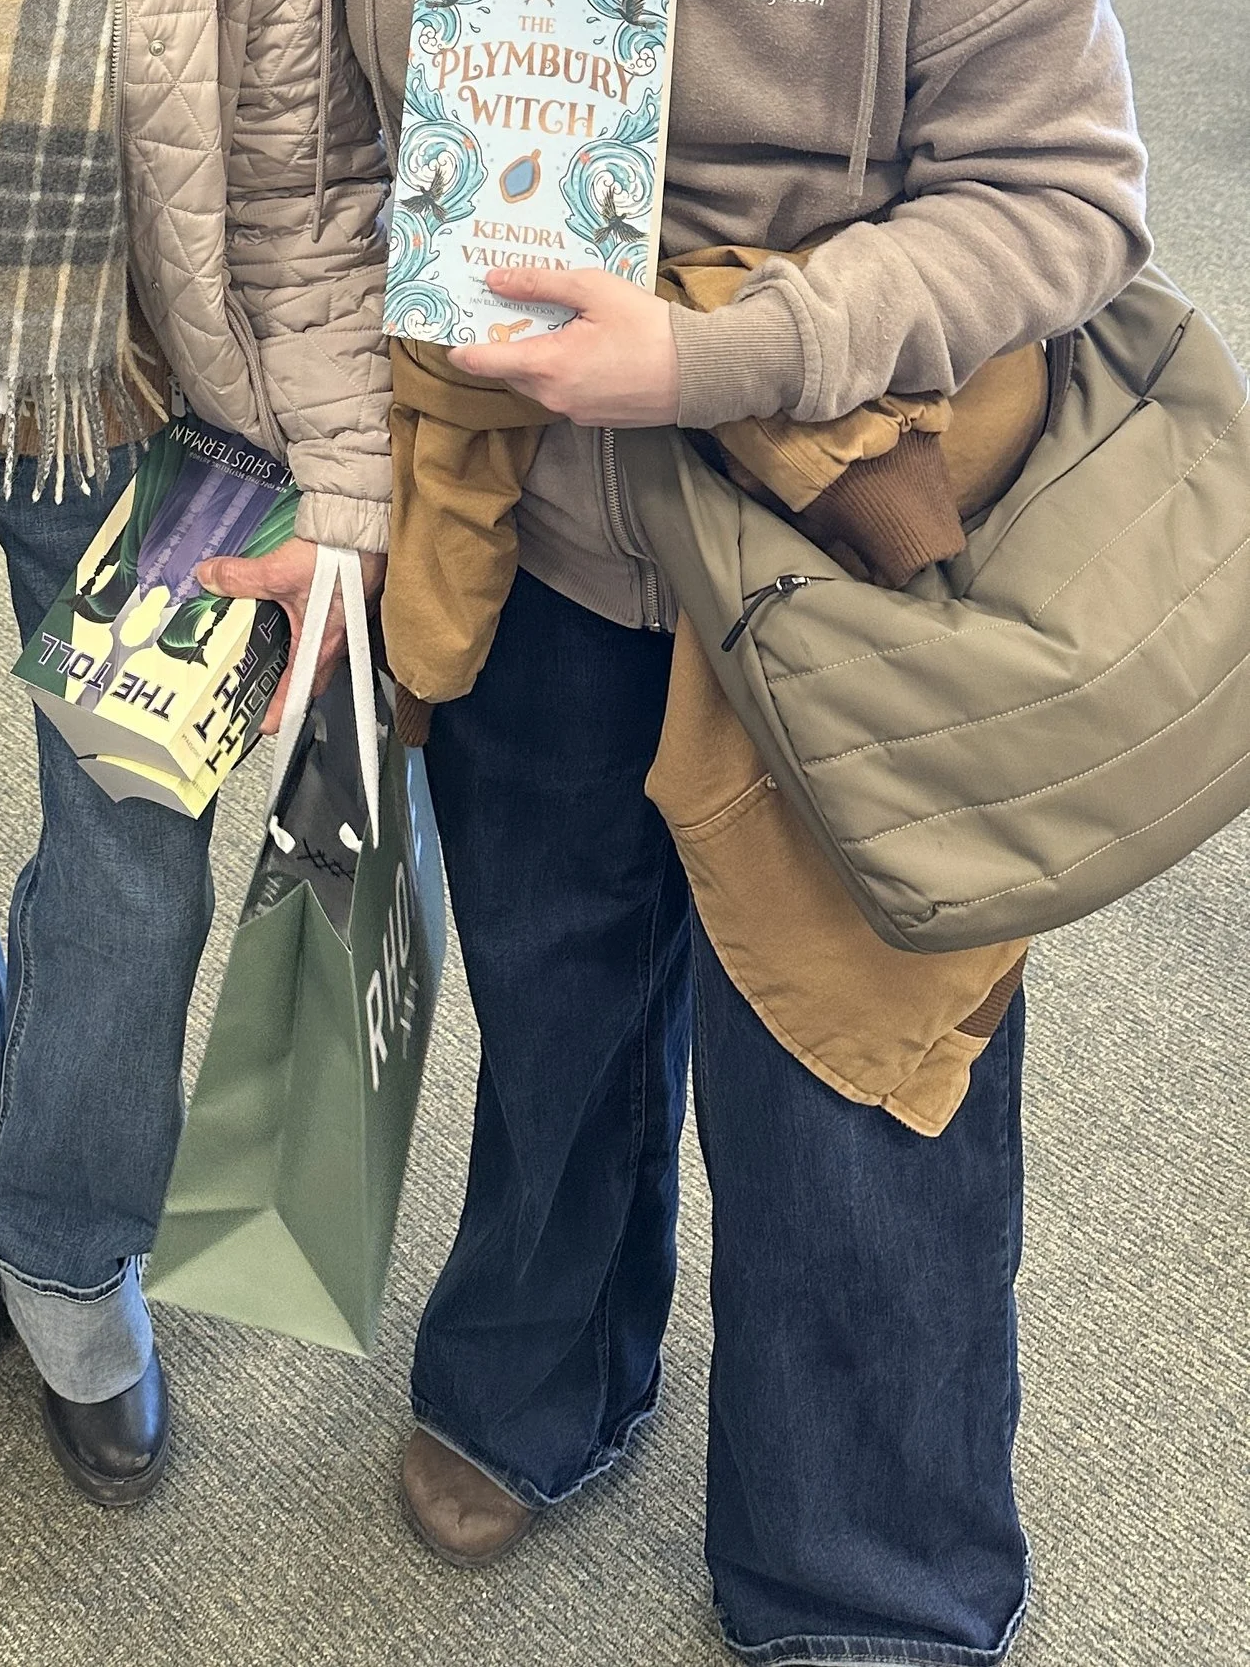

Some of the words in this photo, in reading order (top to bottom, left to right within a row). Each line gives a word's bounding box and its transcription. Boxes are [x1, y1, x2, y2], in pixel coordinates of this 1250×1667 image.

[517, 15, 557, 34] THE
[431, 41, 637, 106] PLYMBURY
[456, 84, 596, 138] WITCH
[461, 244, 572, 271] VAUGHAN
[471, 219, 566, 250] KENDRA
[484, 297, 525, 312] ELIZABETH
[524, 304, 556, 316] WATSON
[168, 423, 277, 479] SHUSTERMAN
[38, 631, 111, 694] TOLL
[109, 671, 179, 722] THE
